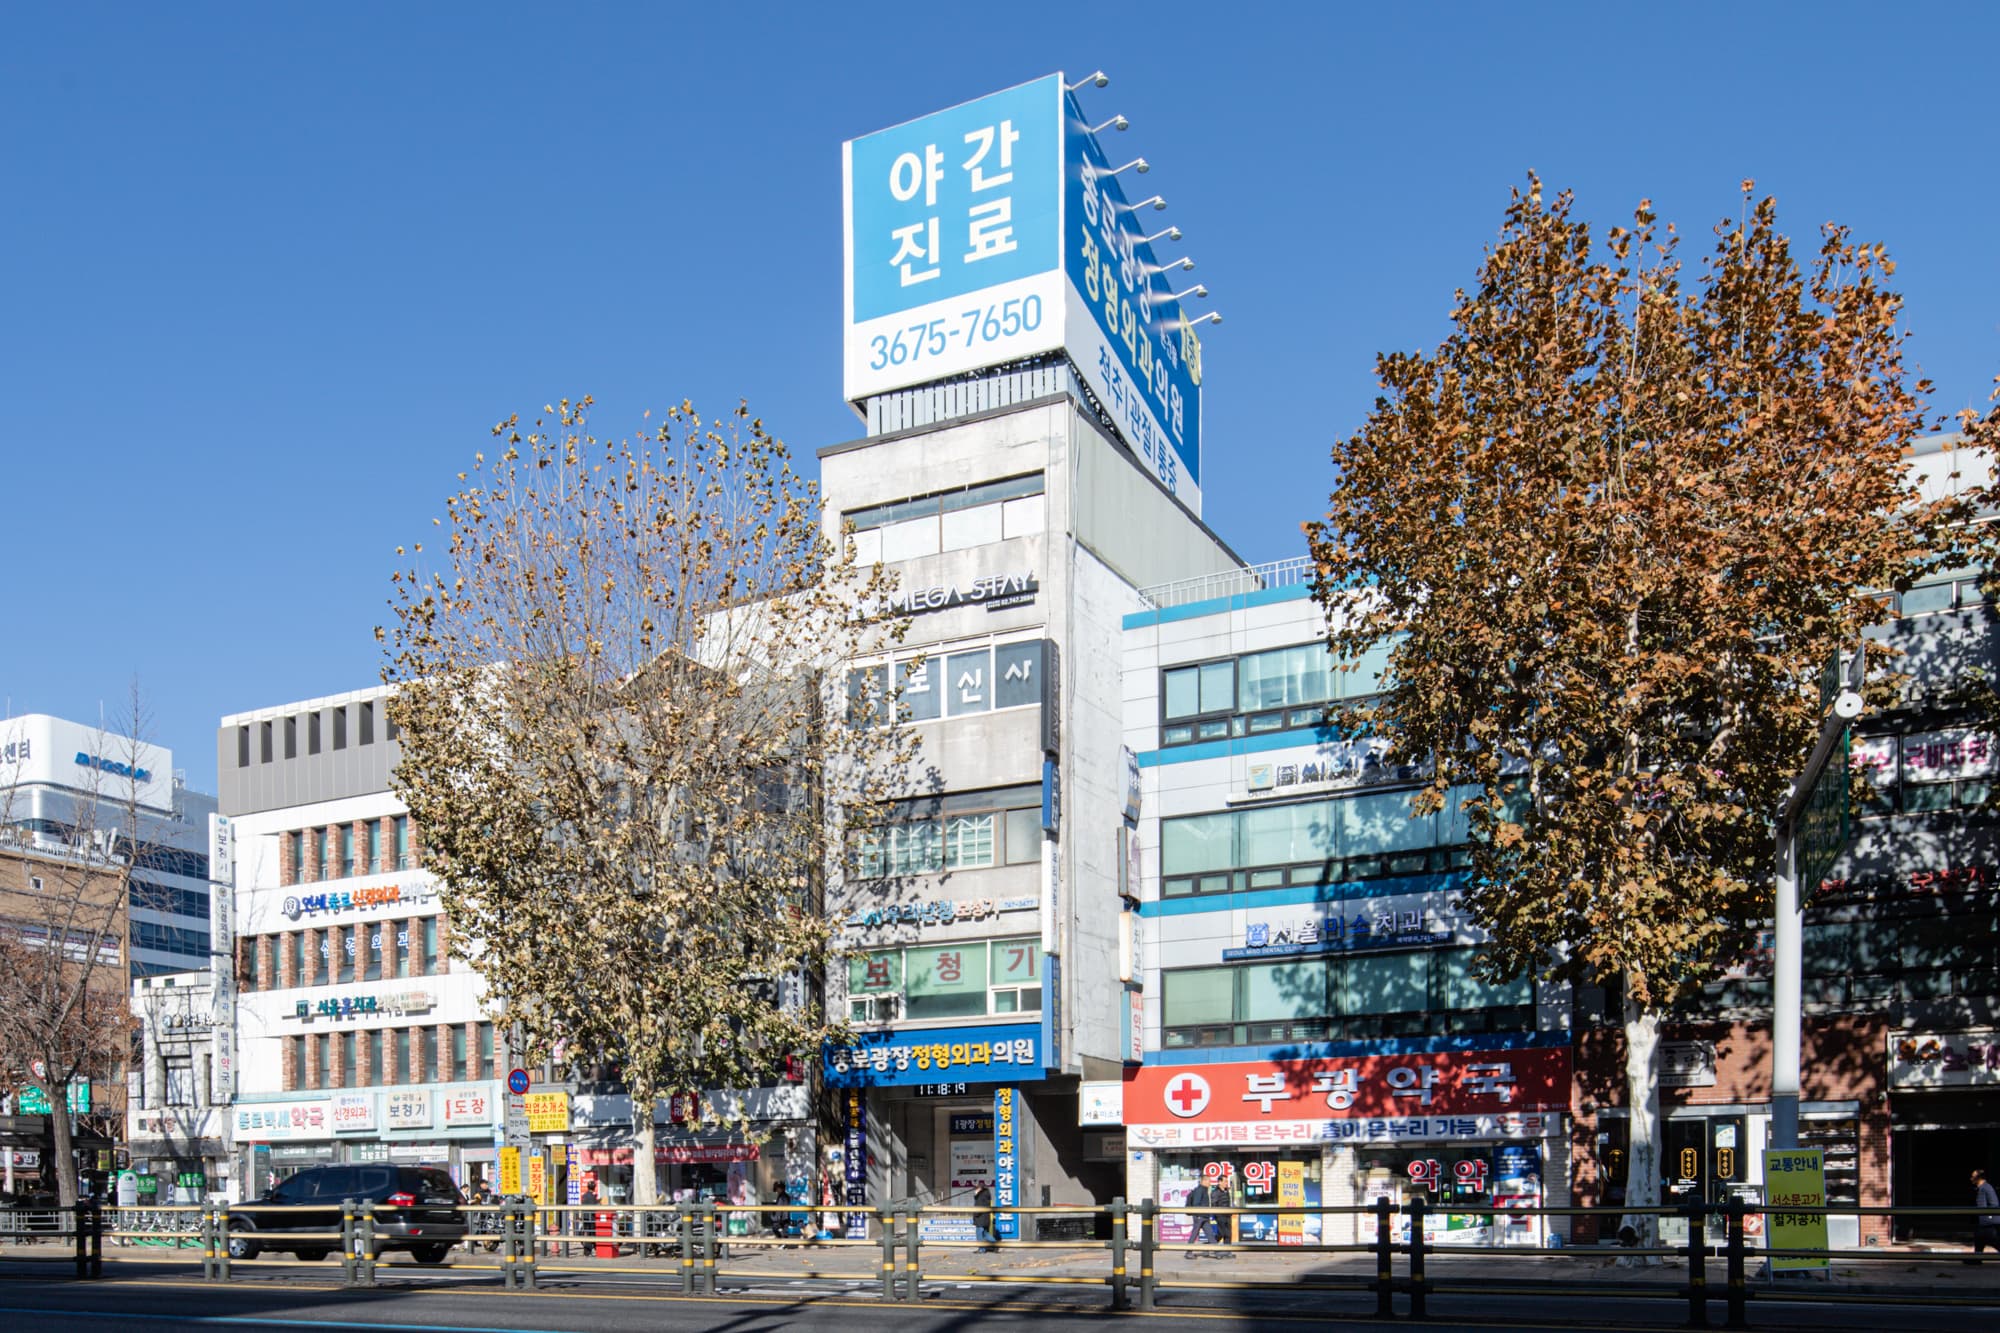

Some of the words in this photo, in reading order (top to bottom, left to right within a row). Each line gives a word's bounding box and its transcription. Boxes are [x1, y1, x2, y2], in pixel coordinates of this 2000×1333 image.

[889, 119, 1019, 206] 야간
[889, 196, 1018, 287] 진료
[1081, 151, 1152, 324] 종로광장
[870, 294, 1042, 370] 3675-7650
[1081, 224, 1184, 446] 정형외과의원
[1098, 345, 1123, 410] 척추
[1130, 393, 1151, 459] 관절
[1158, 437, 1177, 496] 통증
[887, 584, 963, 613] MEGA
[969, 568, 1035, 600] STAY
[0, 738, 31, 764] 센터
[1272, 907, 1425, 945] 서울미소치과
[832, 1038, 1035, 1074] 종로광장정형외과의원
[1241, 1062, 1517, 1113] 부광약국
[239, 1106, 325, 1130] 종로백세약국
[334, 1105, 367, 1121] 신경외과
[389, 1102, 426, 1118] 보청기
[455, 1098, 485, 1116] 도장
[525, 1100, 566, 1114] 직업소개소
[997, 1087, 1014, 1155] 정형외과
[1139, 1127, 1182, 1142] 온누리
[1193, 1125, 1248, 1142] 디지털
[1254, 1123, 1313, 1140] 온누리
[1321, 1120, 1361, 1139] 종이
[1367, 1118, 1429, 1138] 온누리
[1436, 1118, 1477, 1136] 가능
[1244, 1161, 1276, 1194] 약
[1407, 1158, 1442, 1192] 약
[1454, 1158, 1488, 1192] 약
[1769, 1156, 1819, 1172] 교통안내
[1771, 1192, 1821, 1206] 서소문고가
